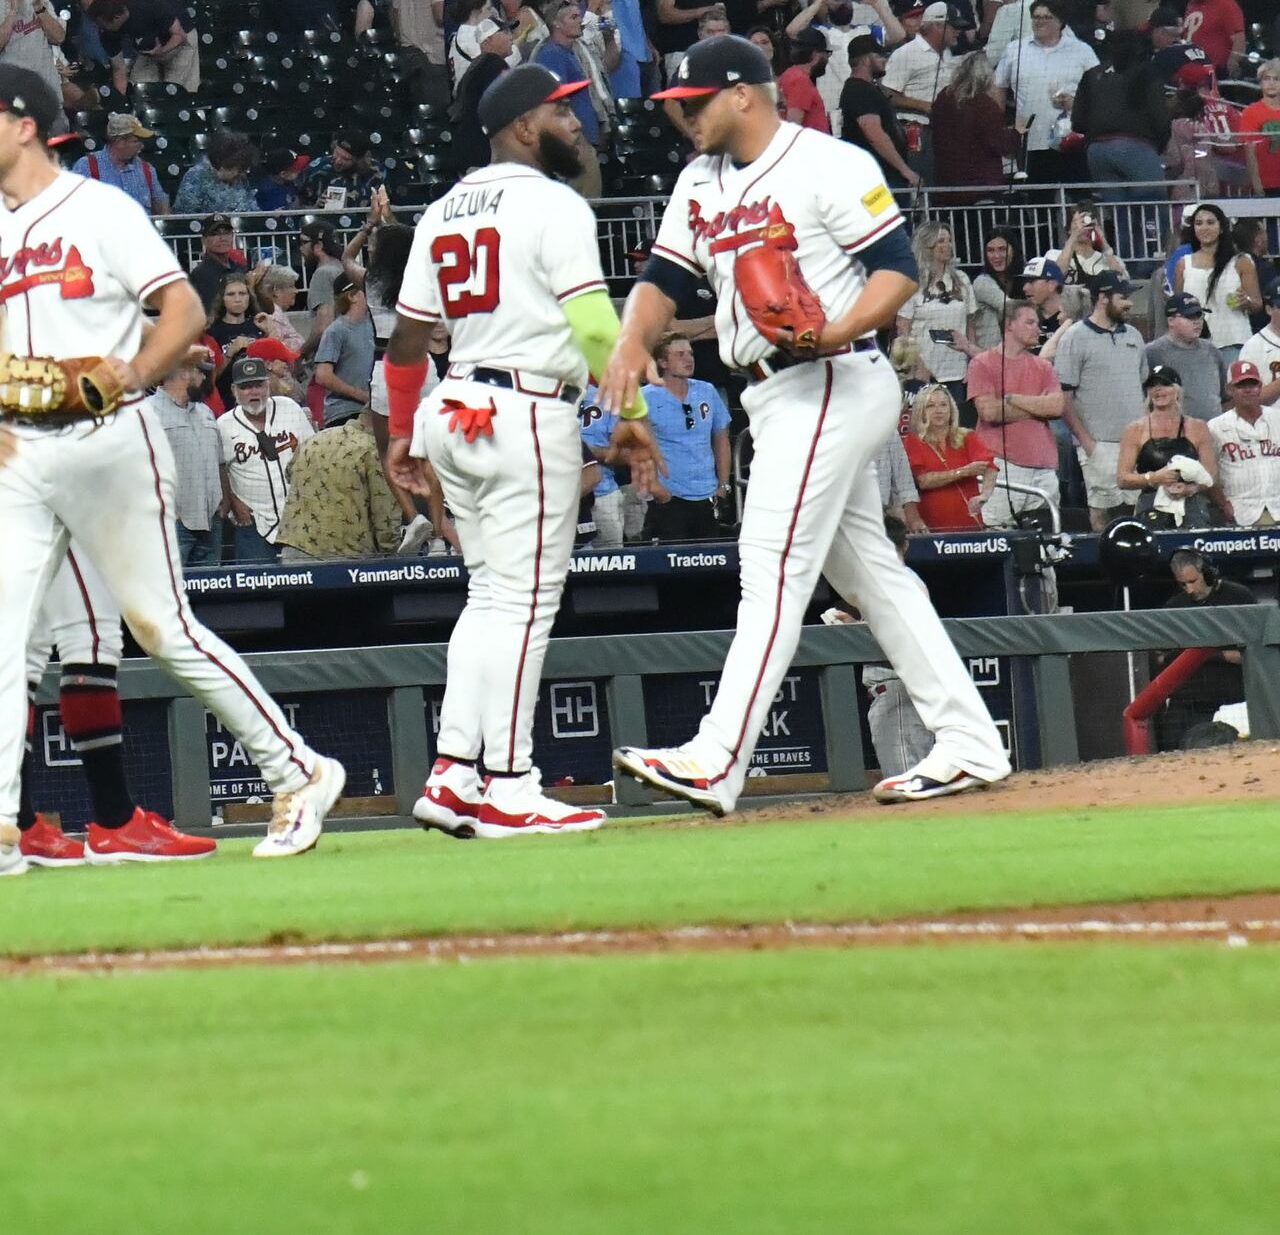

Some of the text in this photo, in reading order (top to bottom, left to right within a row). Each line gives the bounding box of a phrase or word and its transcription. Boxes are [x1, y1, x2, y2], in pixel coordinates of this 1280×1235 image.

[443, 189, 504, 224] OZUNA
[430, 227, 501, 316] 20
[933, 537, 1012, 555] YanmarUS.
[1194, 536, 1253, 555] Compact
[667, 553, 727, 568] Tractors
[181, 569, 313, 592] ompact Equipment
[347, 565, 460, 584] YanmarUS.com
[751, 750, 811, 764] THE BRAVES
[231, 782, 243, 794] OF
[247, 782, 267, 794] THE
